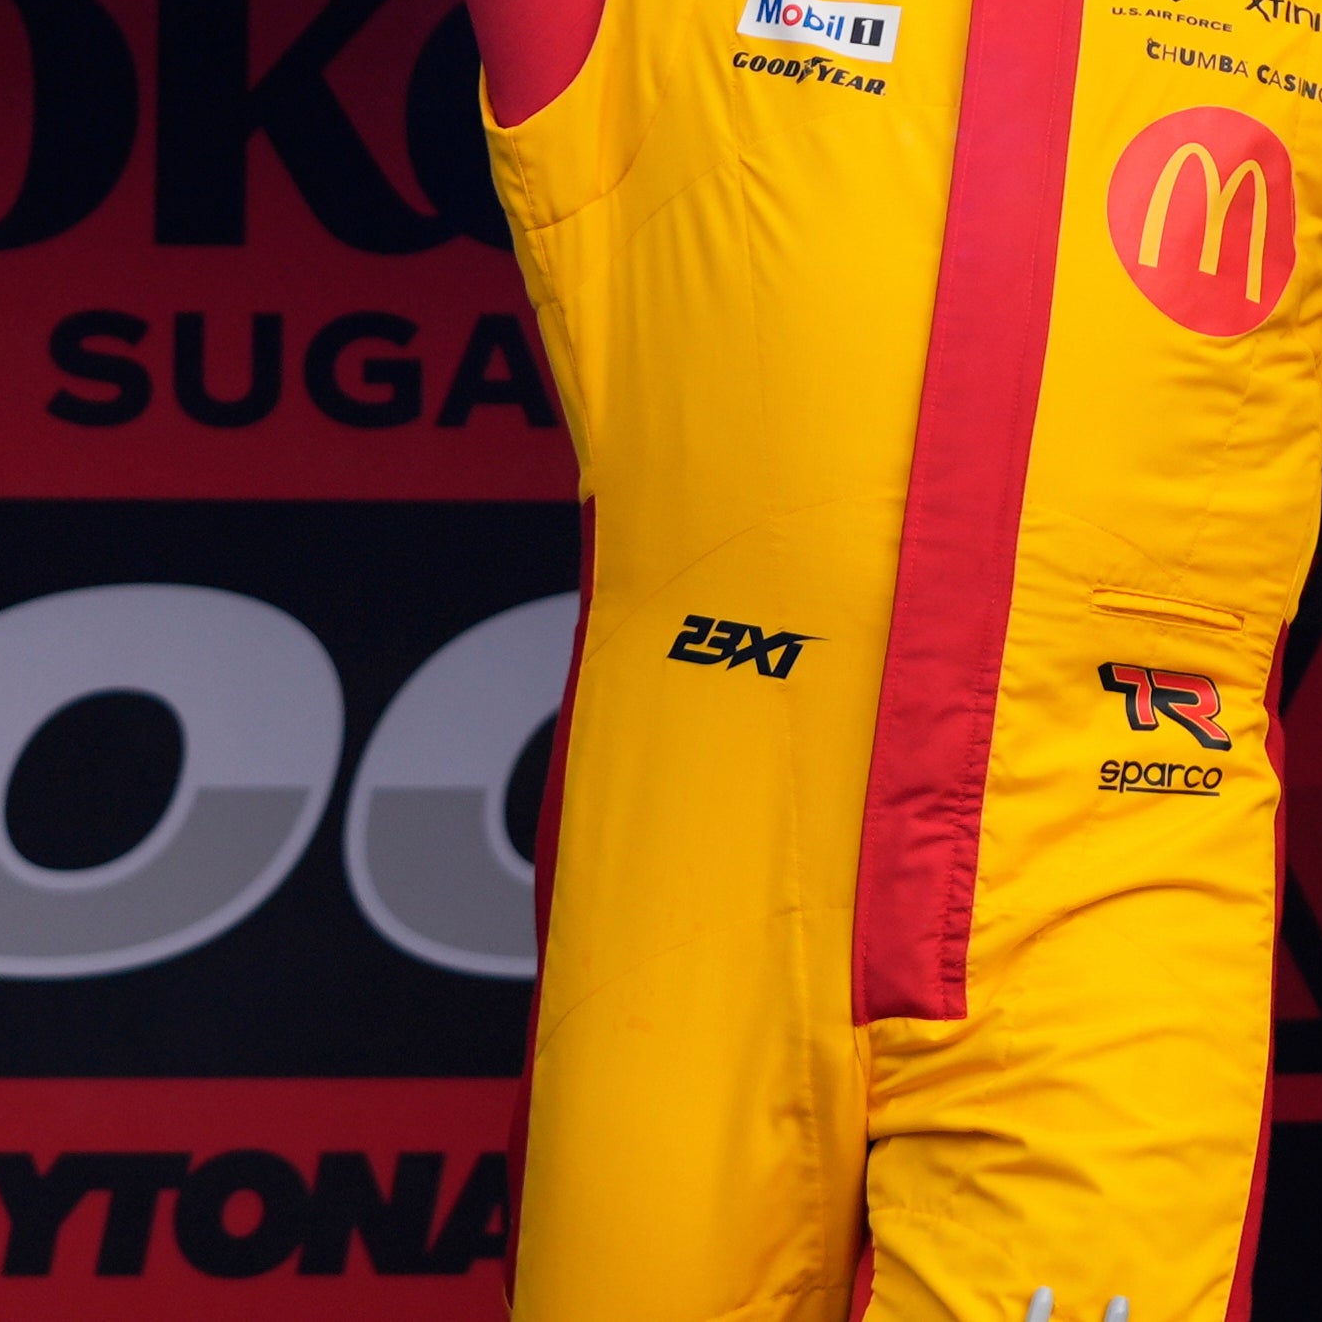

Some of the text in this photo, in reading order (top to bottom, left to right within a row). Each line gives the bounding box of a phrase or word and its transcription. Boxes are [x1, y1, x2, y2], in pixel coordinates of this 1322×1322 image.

[1112, 7, 1233, 33] U.S. AIR FORCE
[732, 52, 886, 95] GOODYEAR
[1146, 39, 1249, 78] CHUMBA
[46, 309, 558, 430] SUGA
[666, 614, 830, 680] 23XI
[1097, 661, 1233, 752] TR
[1098, 759, 1223, 796] sparco
